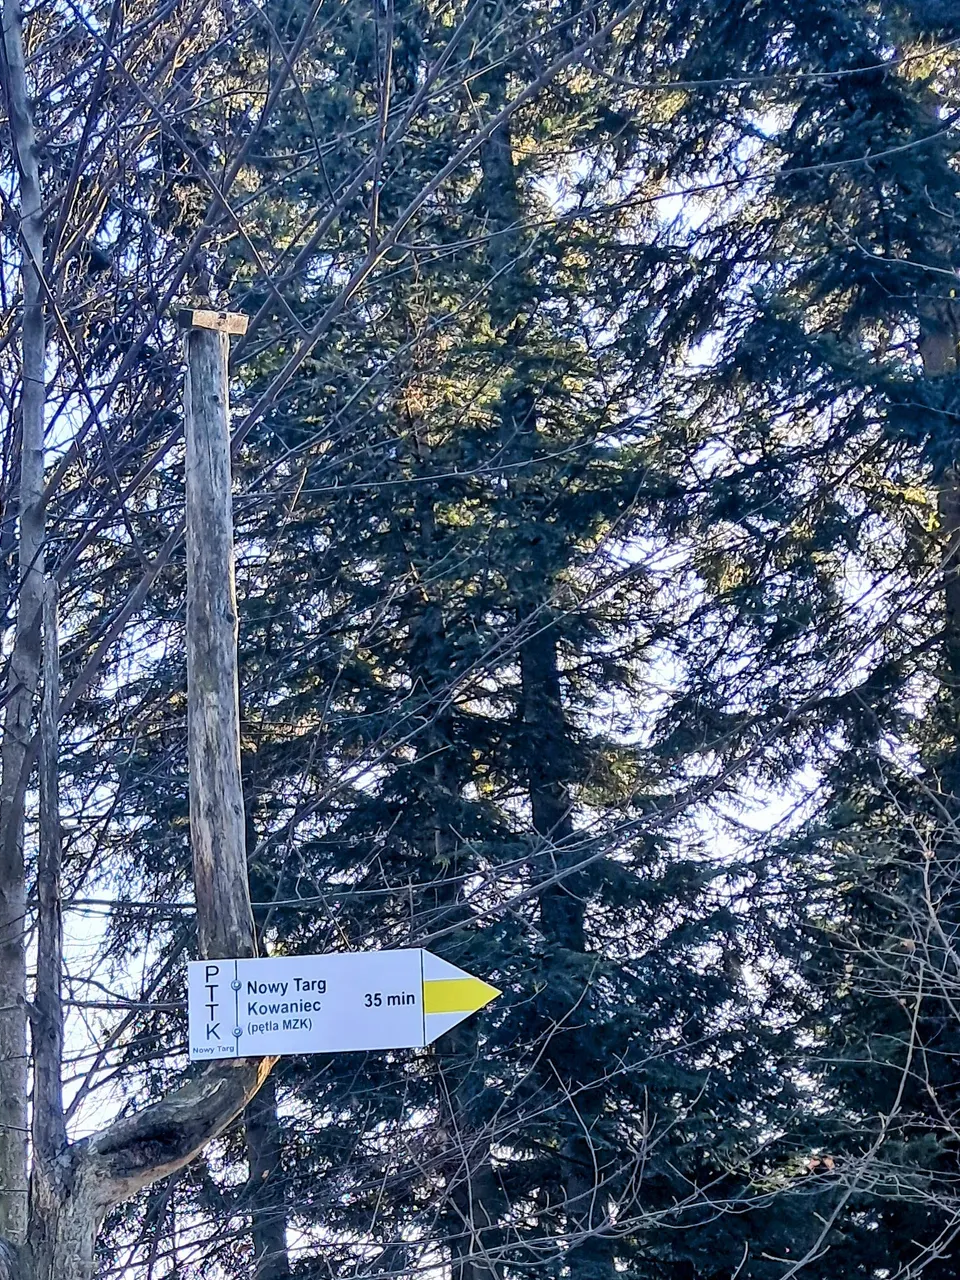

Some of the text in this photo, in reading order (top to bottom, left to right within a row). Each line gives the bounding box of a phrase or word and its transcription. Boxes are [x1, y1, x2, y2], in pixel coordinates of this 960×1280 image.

[247, 978, 327, 997] Nowy Targ
[205, 965, 221, 1041] PTTK
[247, 999, 322, 1016] Kowaniec
[364, 992, 415, 1008] 35 min
[247, 1019, 313, 1036] (pętla MZK)
[192, 1045, 235, 1056] Nowy Targ
